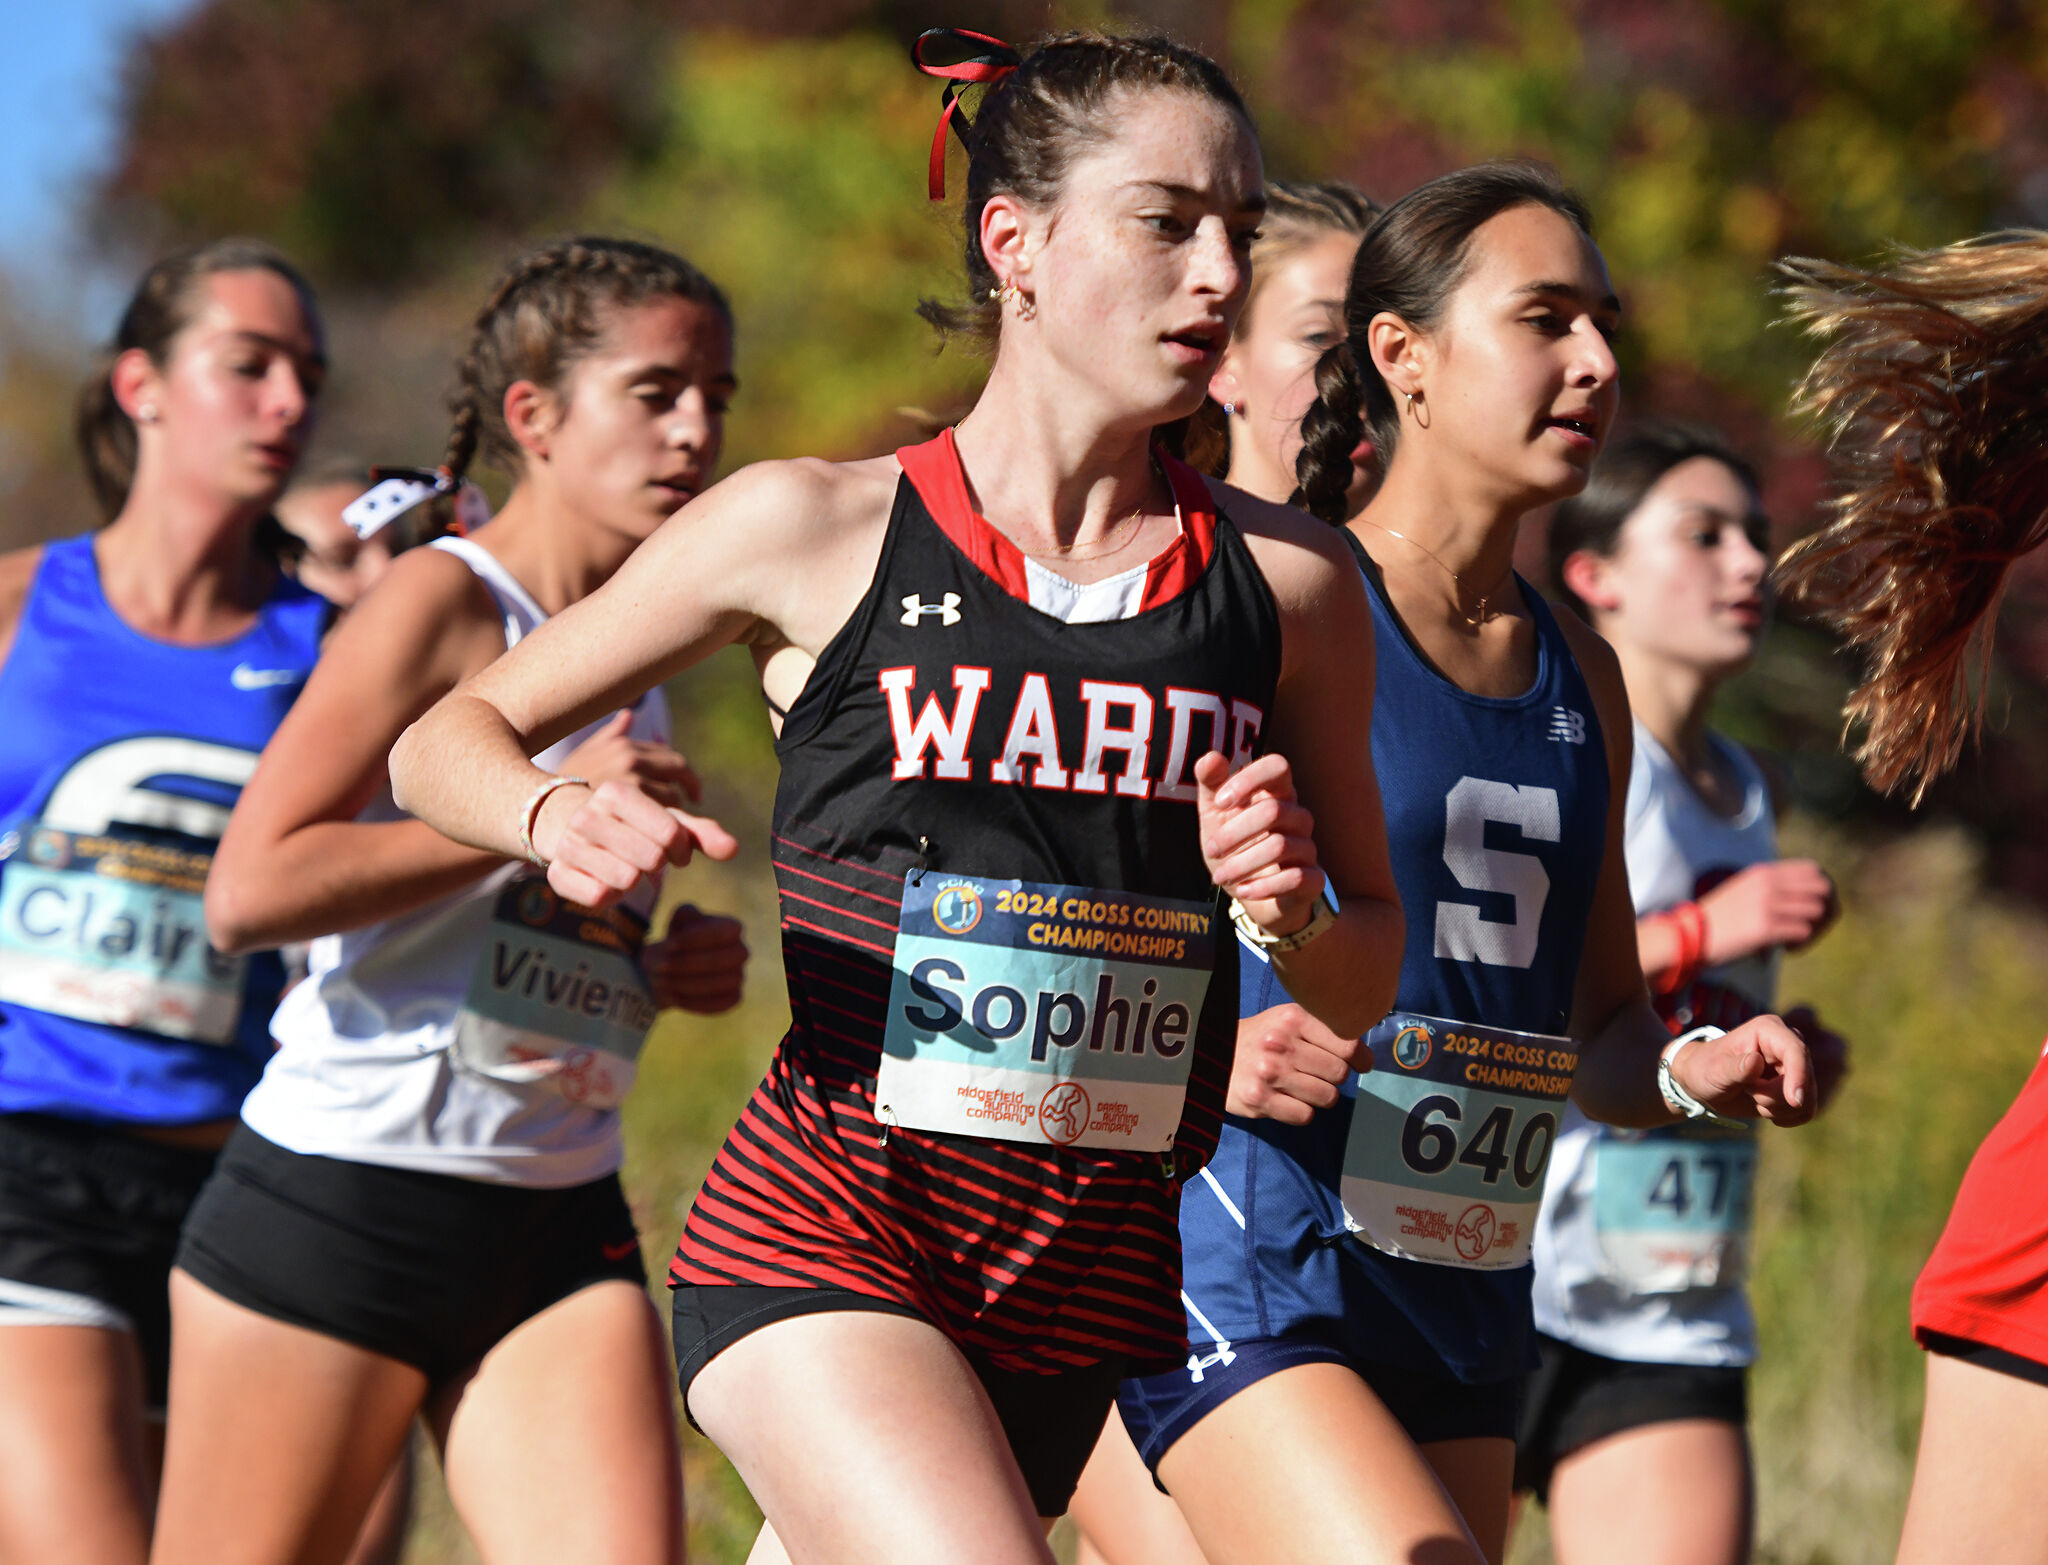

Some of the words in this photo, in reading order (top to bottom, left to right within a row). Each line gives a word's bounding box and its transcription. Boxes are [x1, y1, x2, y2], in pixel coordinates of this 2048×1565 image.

[878, 664, 1264, 802] WARDE
[994, 889, 1058, 917] 2024
[1062, 898, 1130, 925] CROSS
[1134, 905, 1211, 934] COUNTRY
[1433, 775, 1561, 970] S
[1027, 922, 1186, 961] CHAMPIONSHIPS
[903, 956, 1192, 1063] Sophie
[1442, 1032, 1491, 1057] 2024
[1492, 1041, 1545, 1068] CROSS
[1547, 1050, 1579, 1072] COU
[1401, 1093, 1557, 1190] 640
[1646, 1157, 1751, 1220] 47
